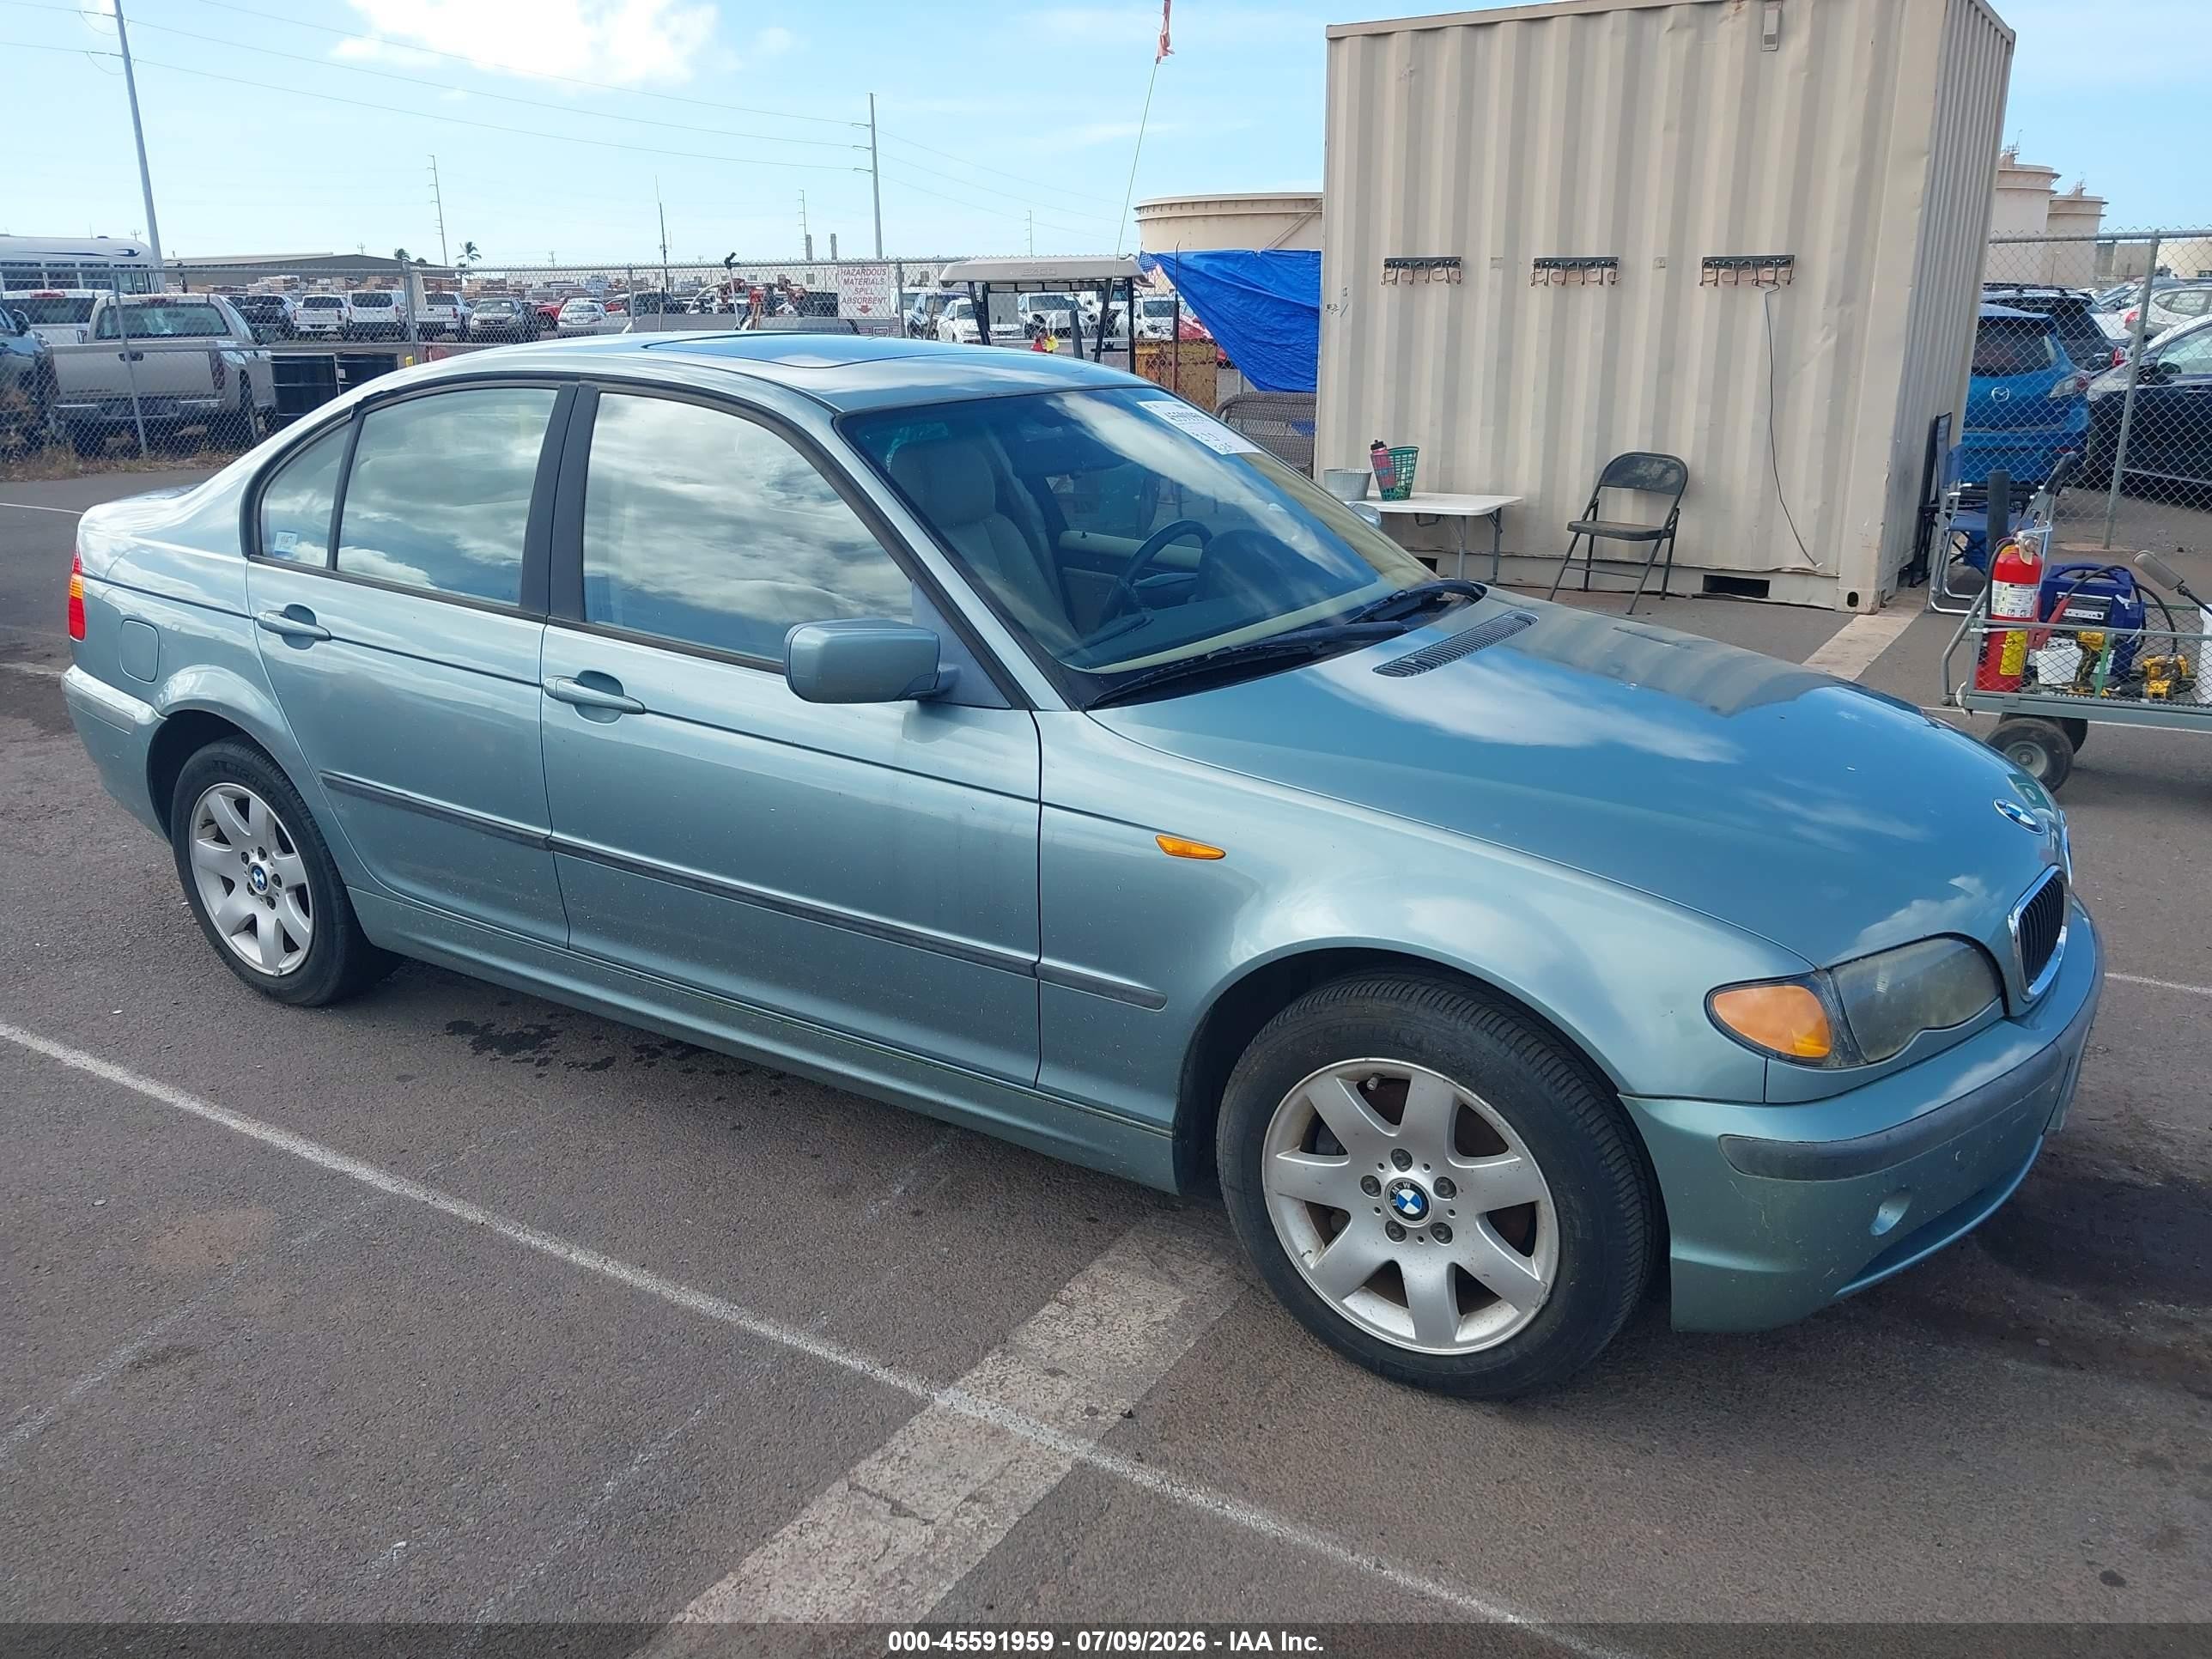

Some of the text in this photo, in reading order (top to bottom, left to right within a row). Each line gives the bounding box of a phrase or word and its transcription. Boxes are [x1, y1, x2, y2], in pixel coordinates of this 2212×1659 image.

[842, 277, 885, 286] MATERIALS
[854, 287, 874, 295] SPILL
[842, 296, 888, 305] ABSORBENT
